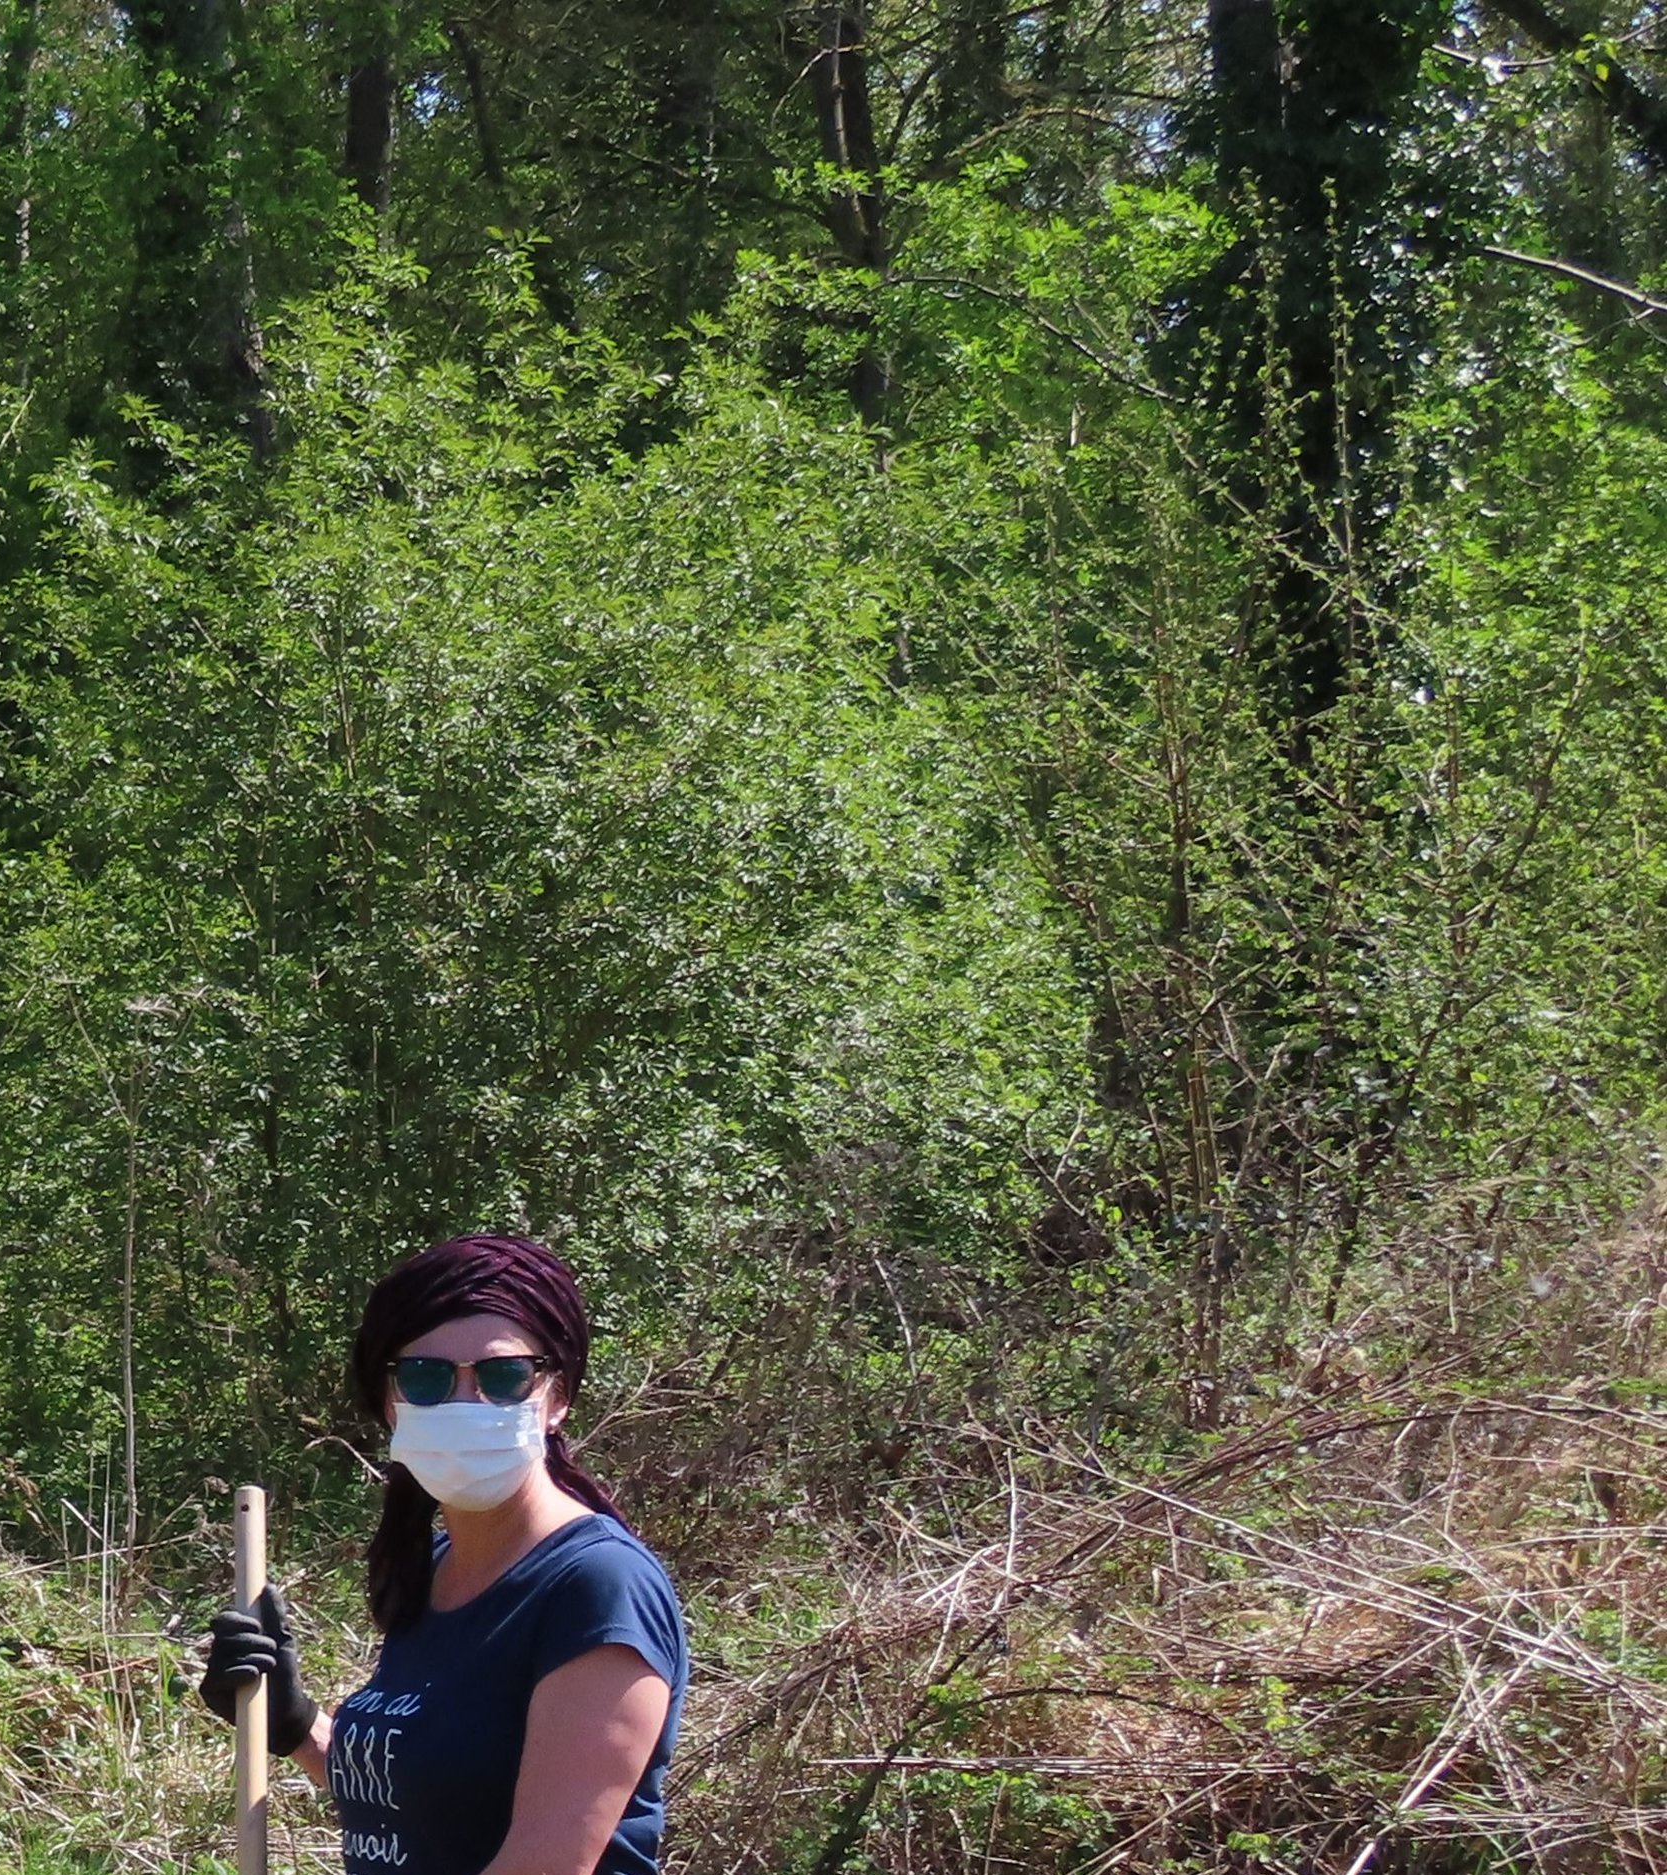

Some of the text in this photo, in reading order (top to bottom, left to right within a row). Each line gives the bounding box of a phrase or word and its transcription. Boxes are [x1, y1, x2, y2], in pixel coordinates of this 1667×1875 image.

[346, 1682, 432, 1717] en ai
[326, 1717, 404, 1811] ARRE
